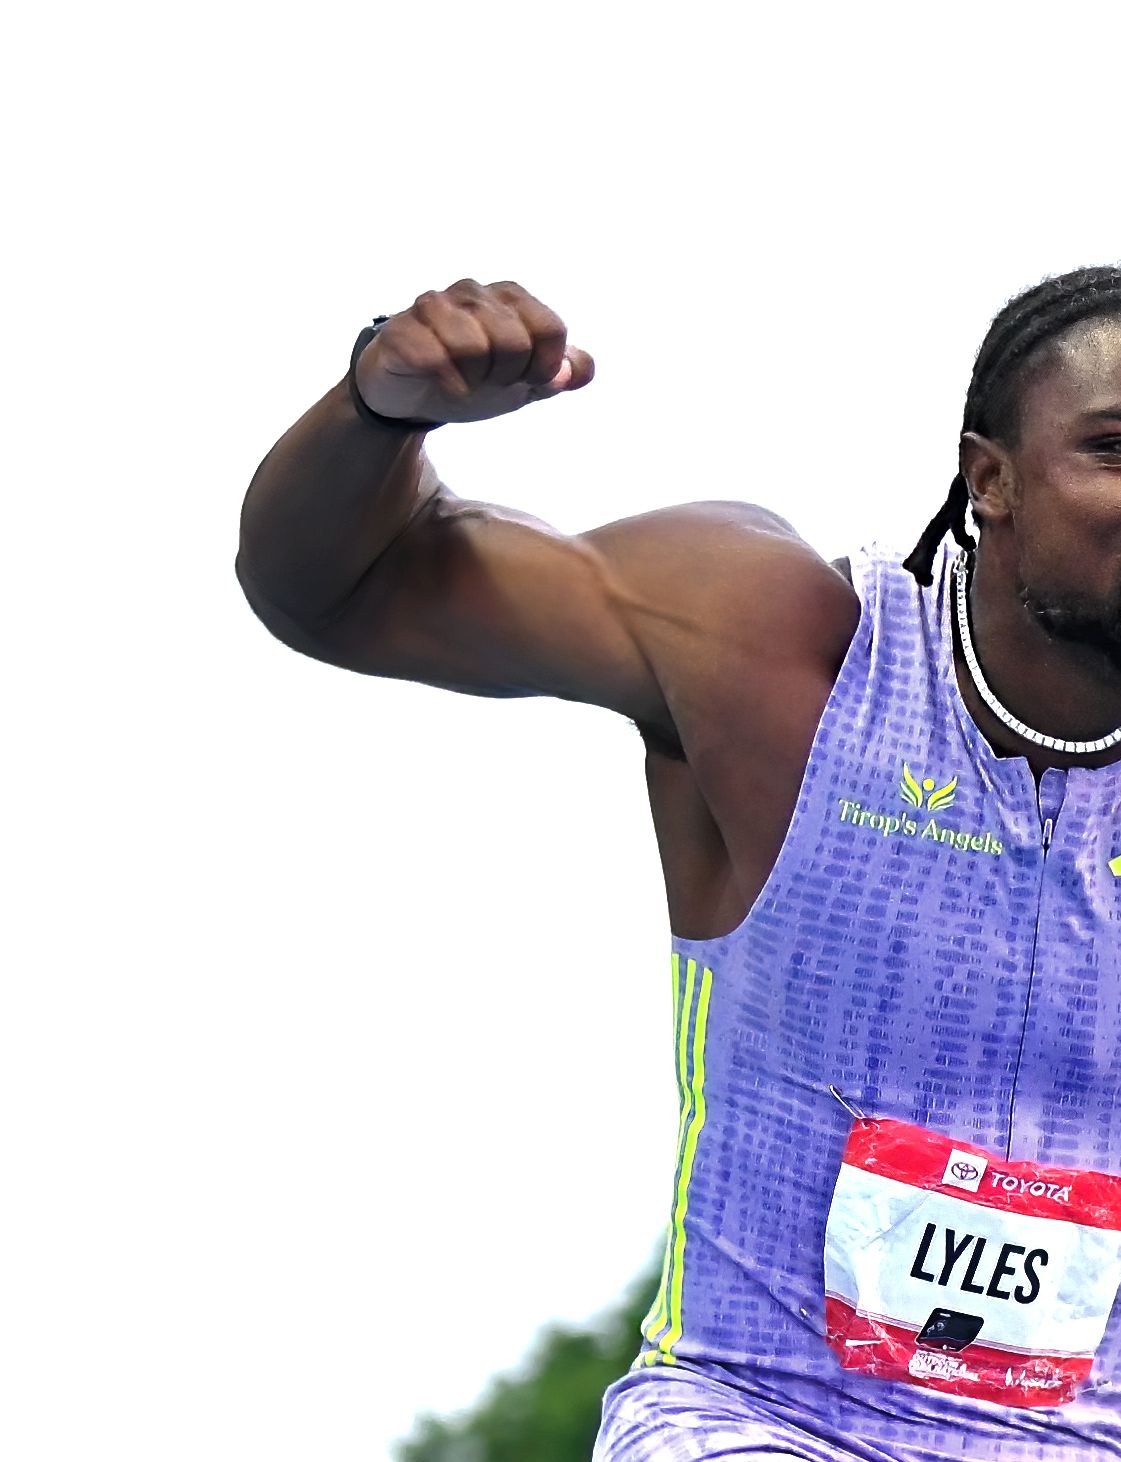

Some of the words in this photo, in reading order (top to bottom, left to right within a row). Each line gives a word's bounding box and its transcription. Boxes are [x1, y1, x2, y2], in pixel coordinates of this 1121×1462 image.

[839, 798, 917, 837] Tirop's
[921, 818, 1004, 856] Angels
[991, 1171, 1070, 1203] TOYOTA
[910, 1222, 1049, 1305] LYLES
